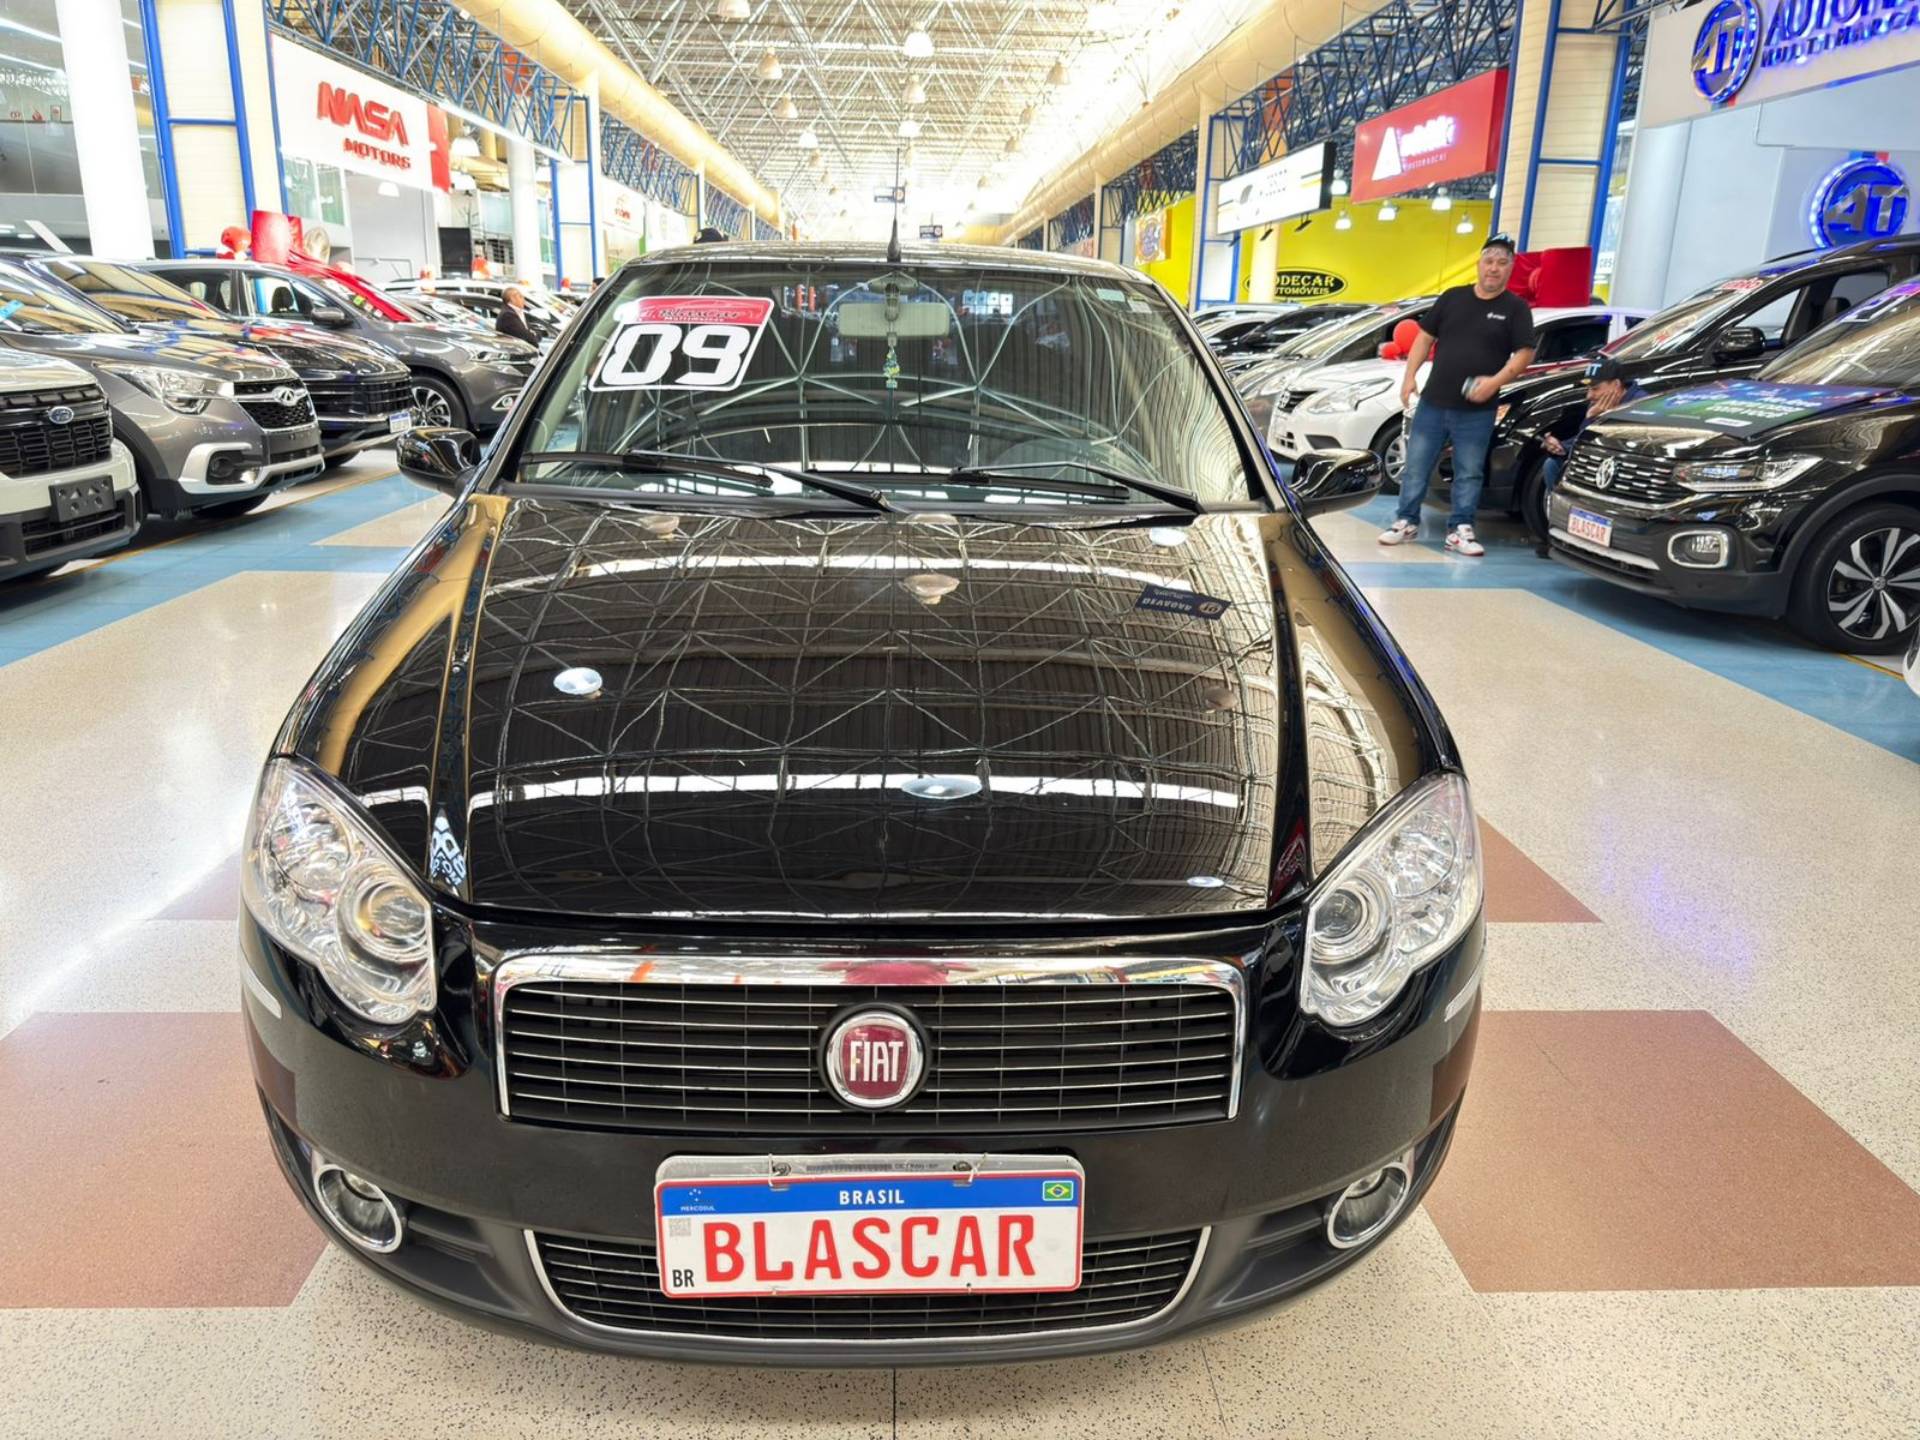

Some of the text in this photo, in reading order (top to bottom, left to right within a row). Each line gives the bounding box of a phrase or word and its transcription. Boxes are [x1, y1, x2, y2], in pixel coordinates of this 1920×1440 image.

[317, 81, 410, 147] NASA
[344, 138, 411, 169] MOTORS
[1823, 183, 1907, 233] AT
[601, 324, 751, 386] 09
[850, 1040, 904, 1082] FIAT
[839, 1189, 904, 1206] BRASIL
[703, 1215, 1036, 1283] BLASCAR
[672, 1269, 695, 1288] BR
